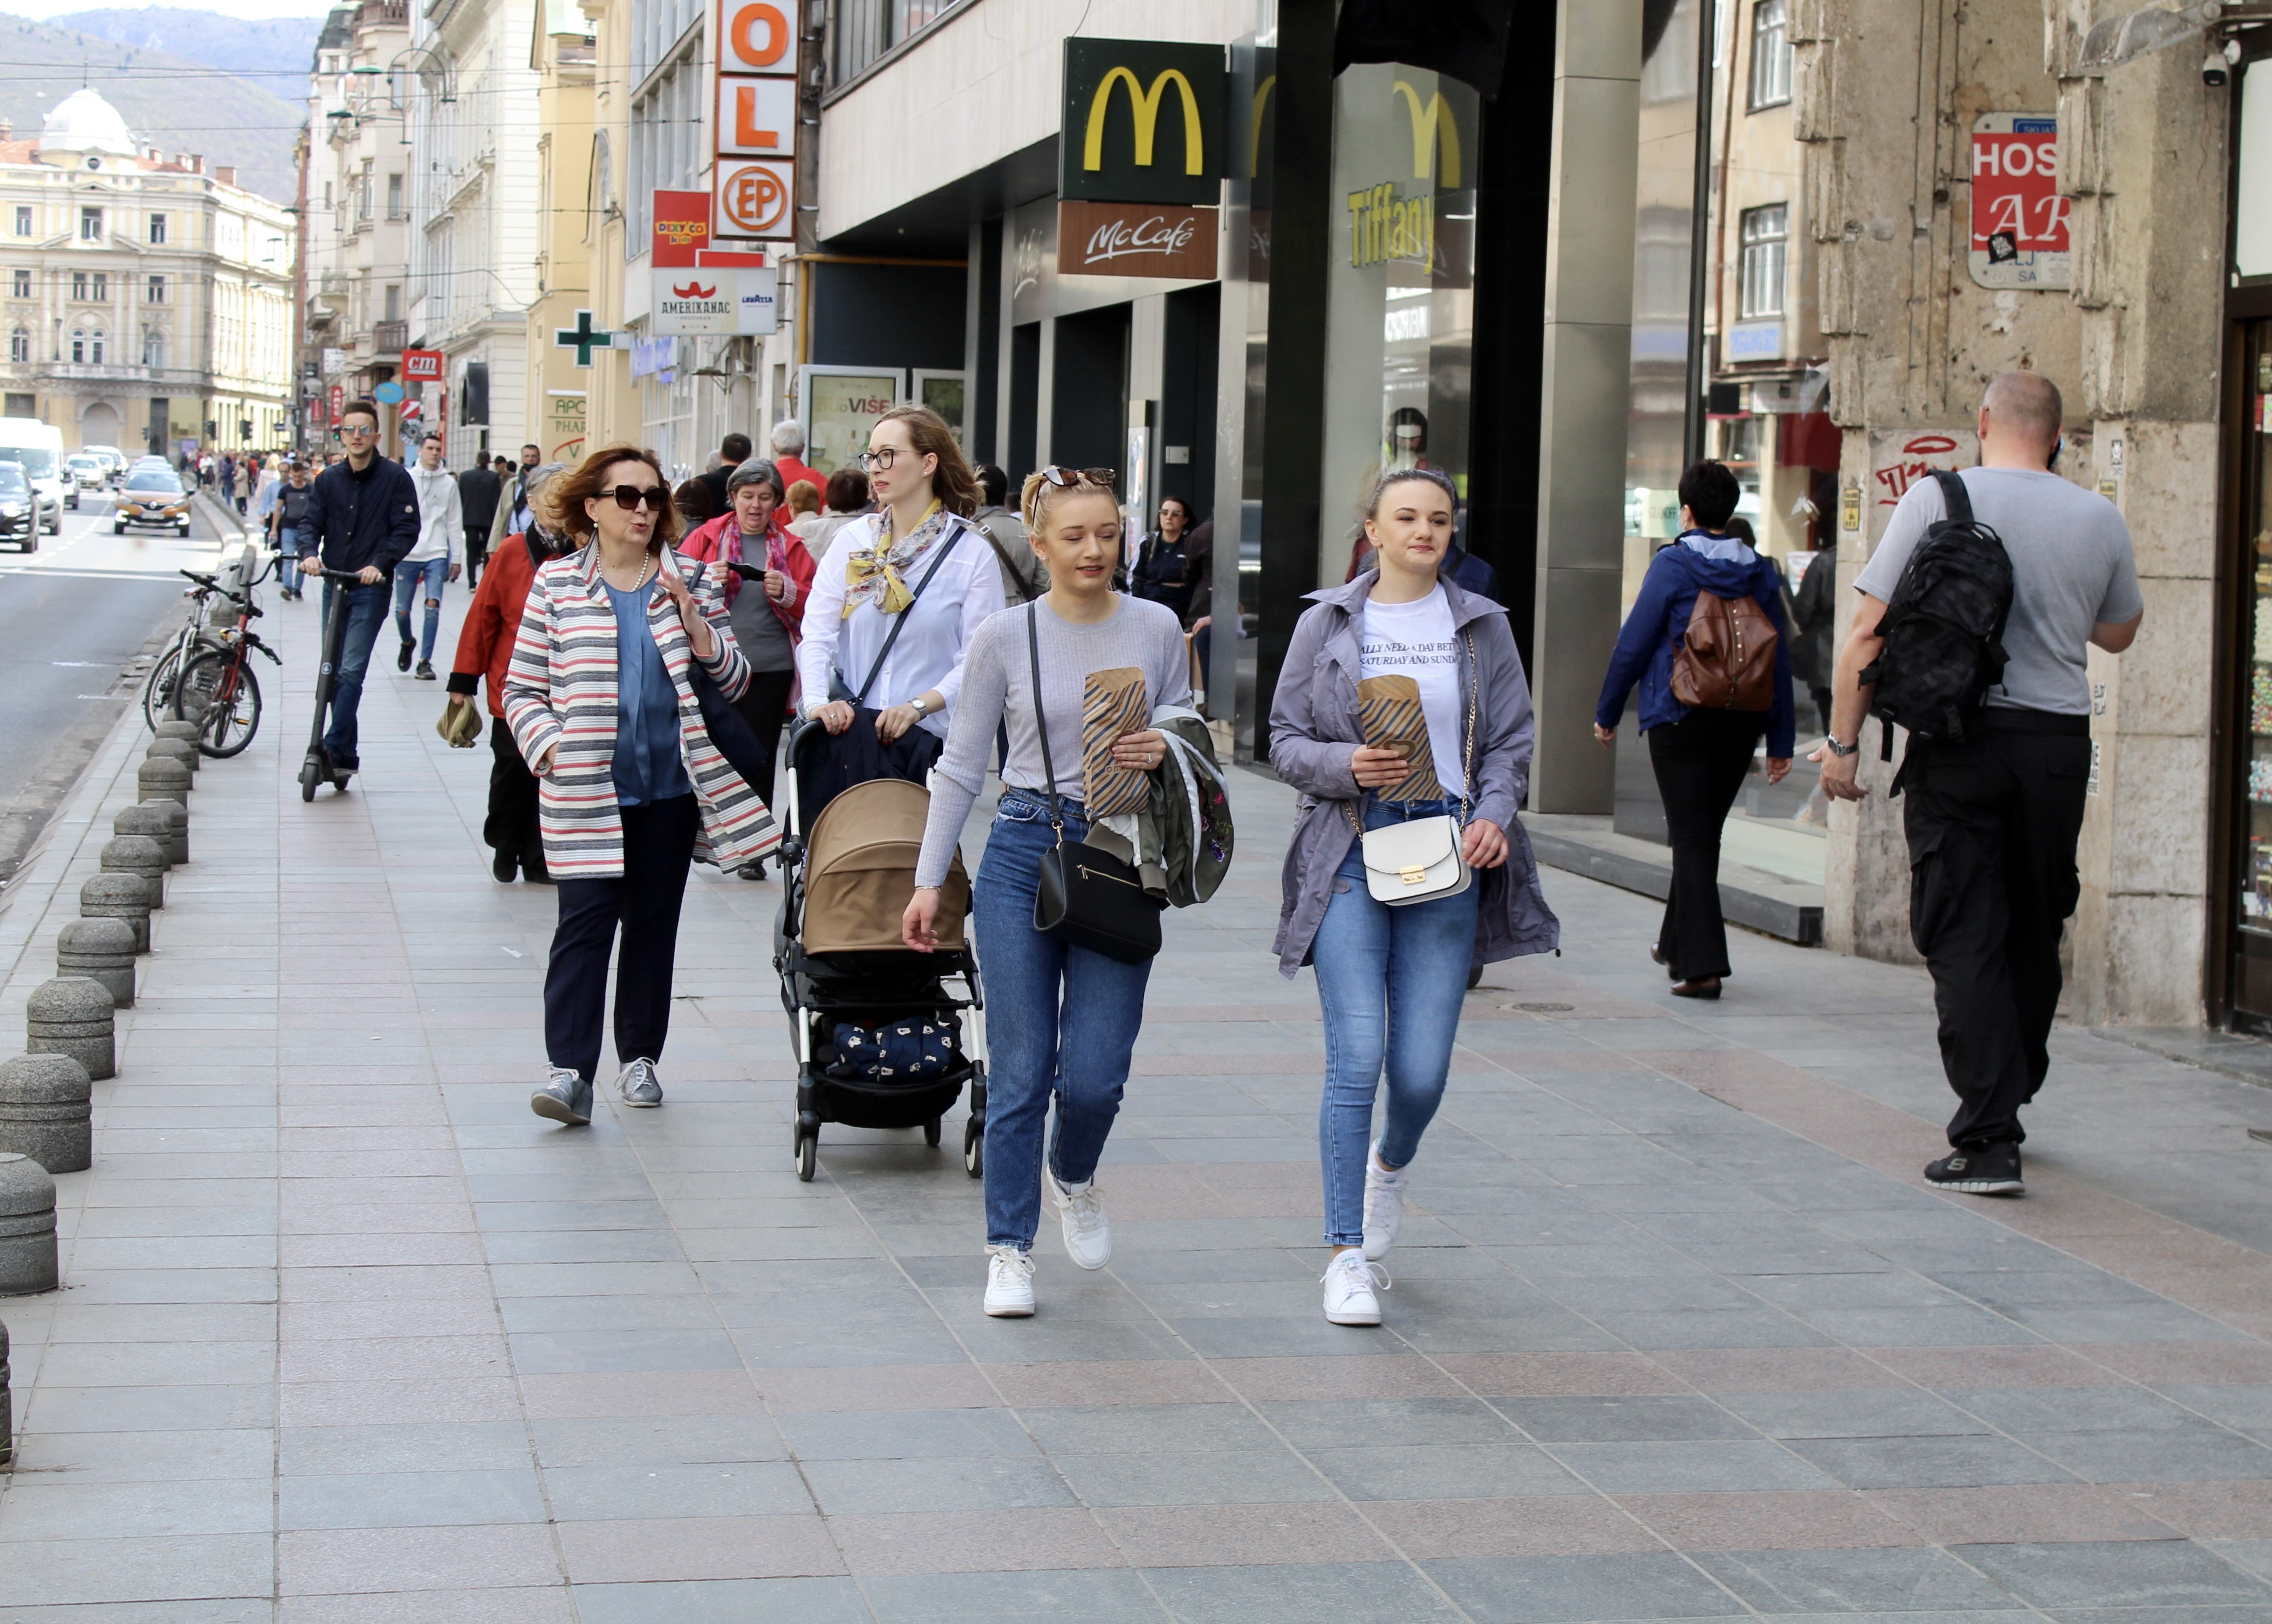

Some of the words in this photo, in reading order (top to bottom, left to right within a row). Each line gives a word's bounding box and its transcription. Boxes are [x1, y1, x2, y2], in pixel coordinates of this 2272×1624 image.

[737, 179, 777, 219] EP
[659, 223, 686, 233] DEXY
[689, 224, 704, 233] CO
[1347, 181, 1435, 276] Tiffany
[1085, 211, 1195, 262] McCafé
[742, 294, 773, 303] LAVAZZA
[662, 302, 730, 314] AMERIKANAC
[407, 357, 437, 370] cm
[849, 395, 890, 415] VIŠE
[1418, 643, 1435, 652] DAY
[1360, 656, 1408, 665] SATURDAY
[1409, 655, 1429, 665] AND
